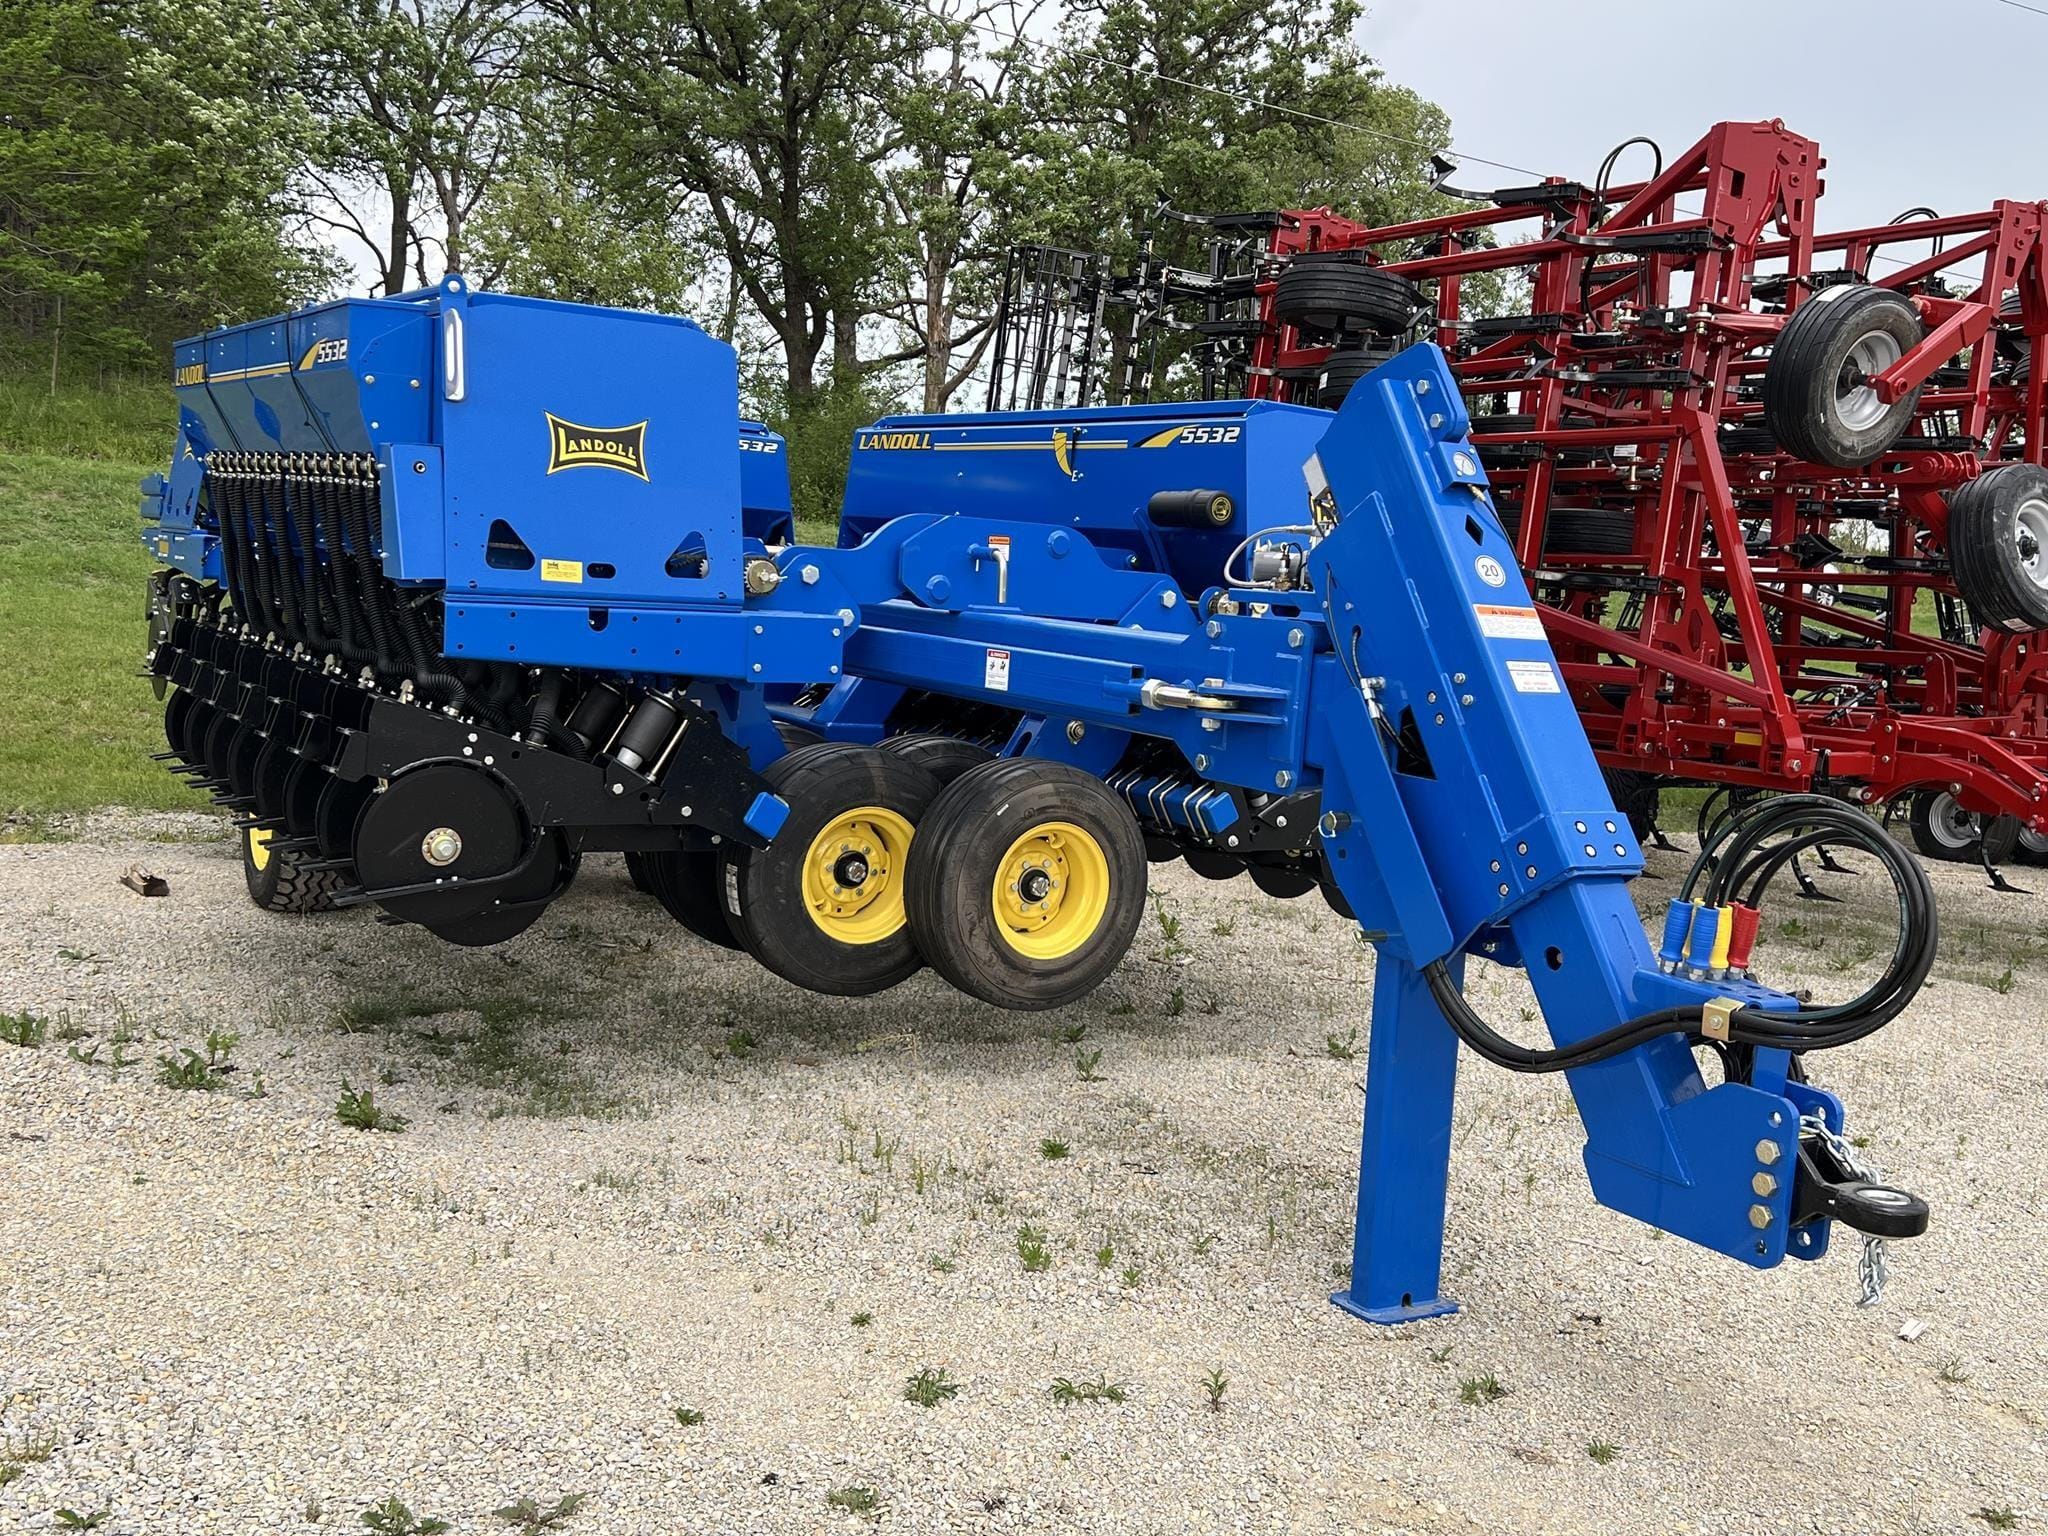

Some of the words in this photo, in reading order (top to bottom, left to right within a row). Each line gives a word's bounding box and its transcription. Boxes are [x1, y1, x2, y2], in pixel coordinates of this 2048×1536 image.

[317, 339, 348, 363] 5532
[858, 433, 932, 450] LANDOLL
[1179, 426, 1241, 444] 5532
[557, 426, 638, 468] LANDOLL
[1071, 469, 1078, 482] E
[1481, 564, 1499, 577] 20
